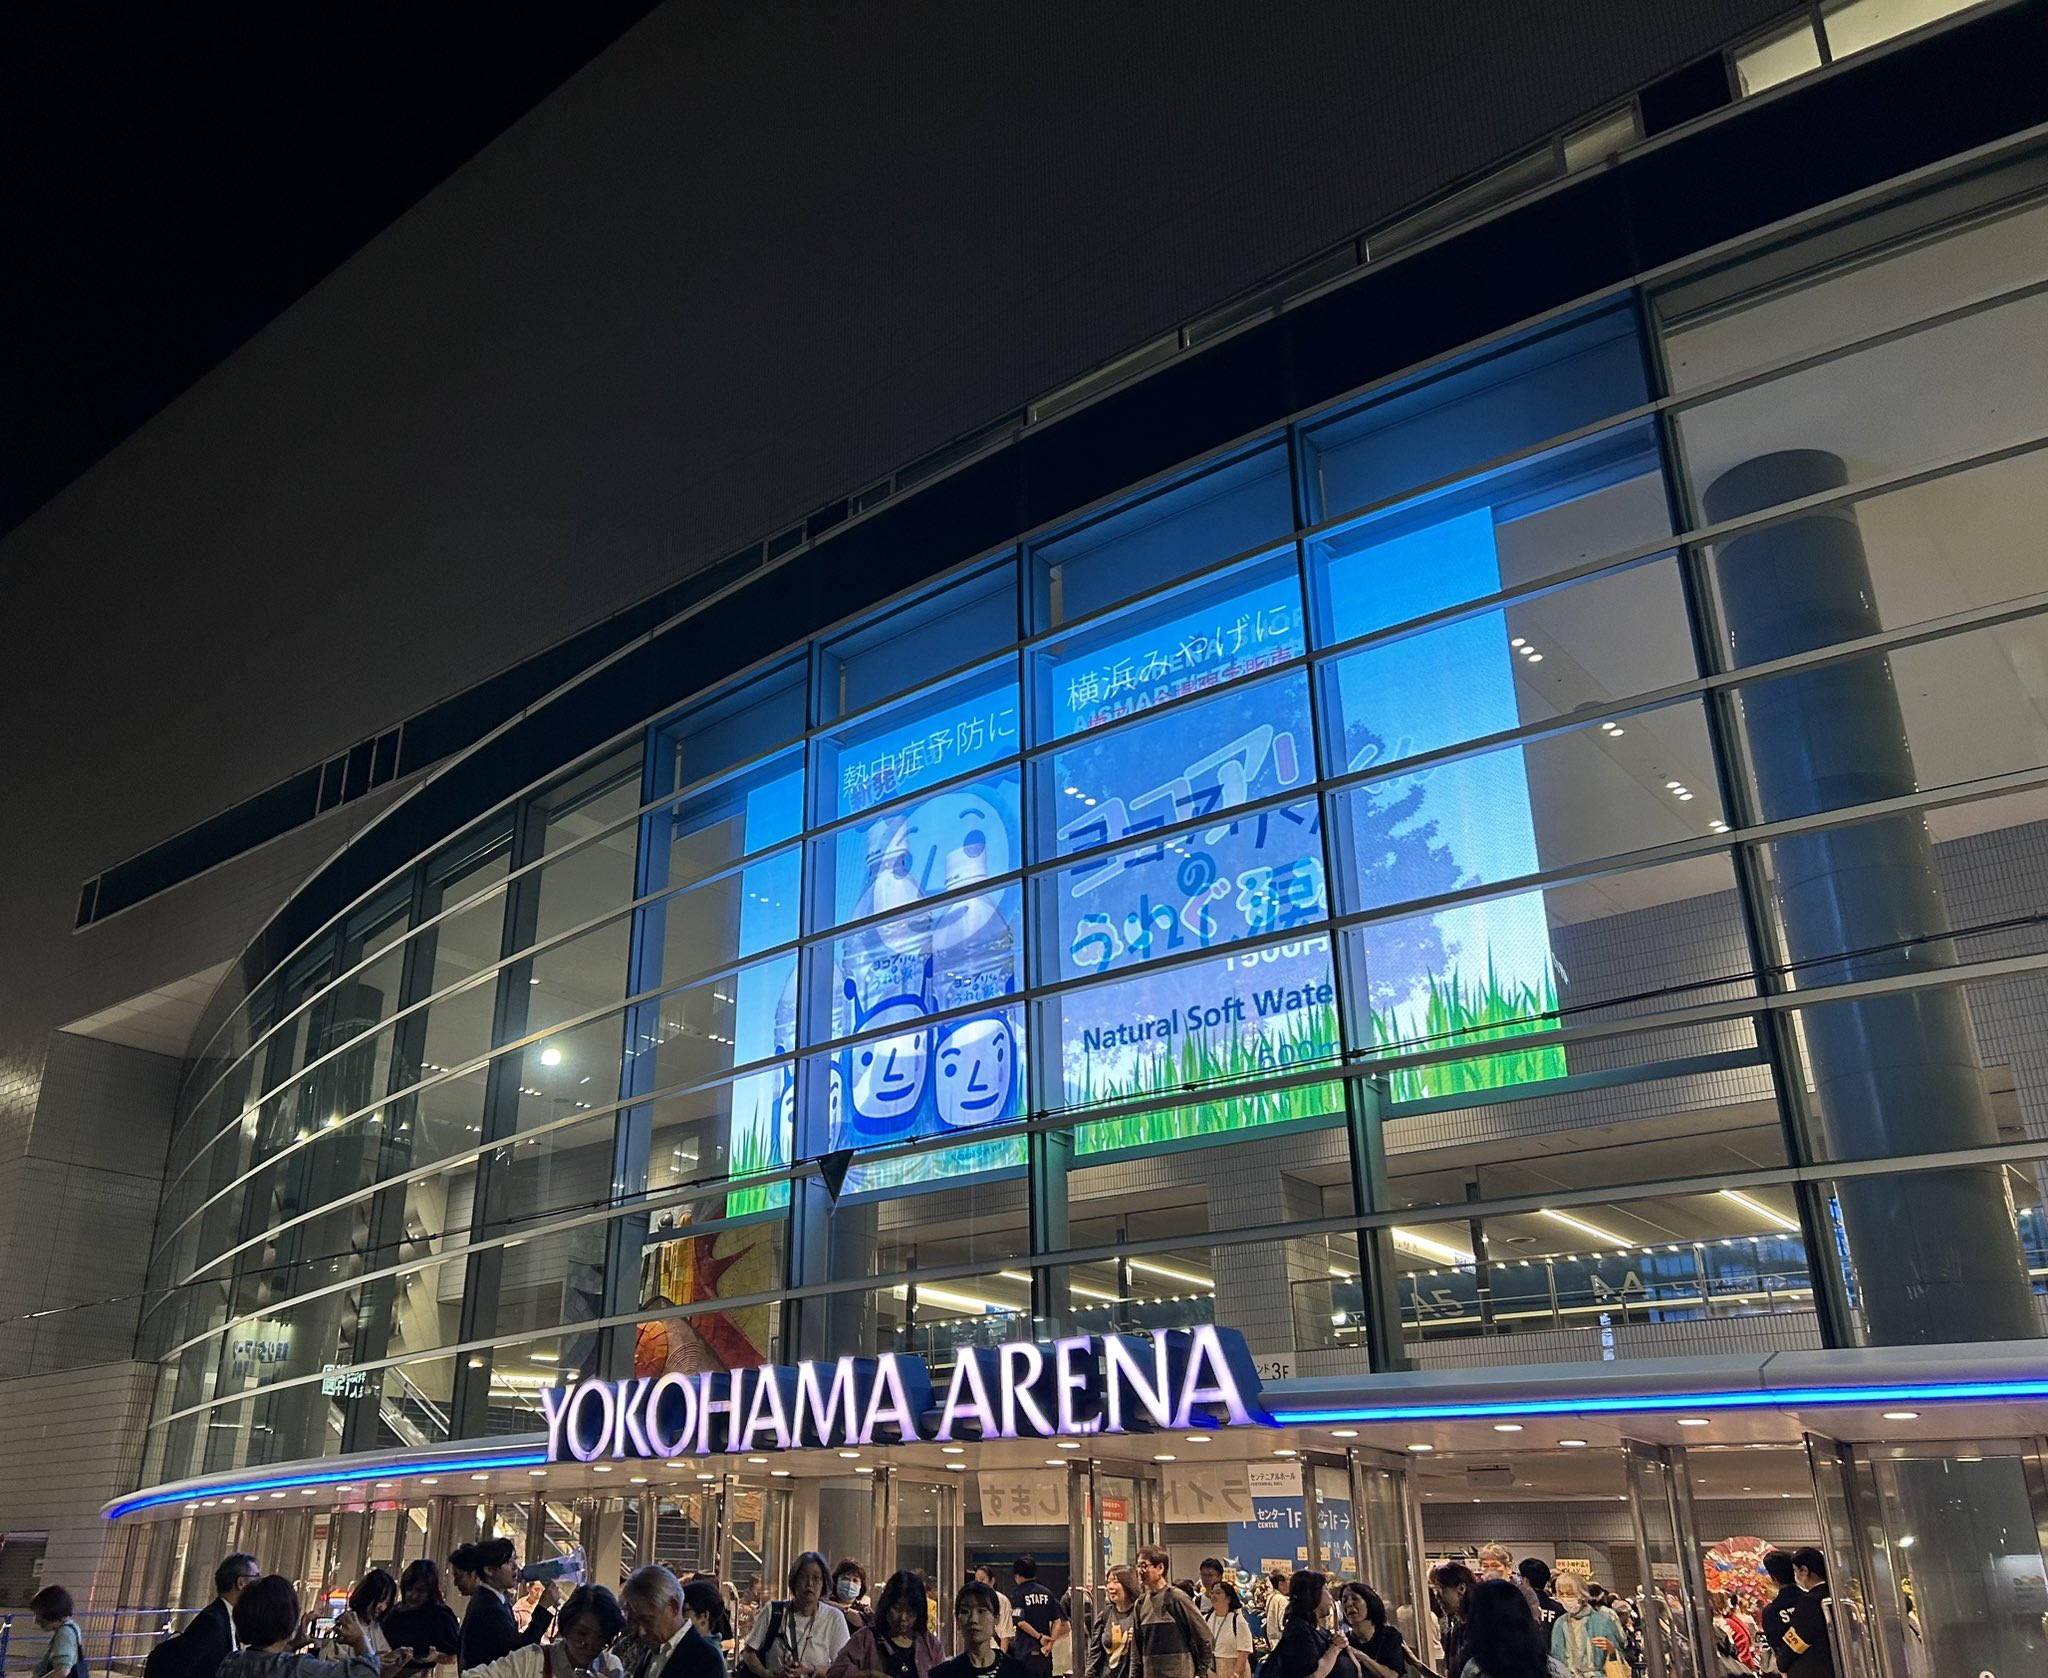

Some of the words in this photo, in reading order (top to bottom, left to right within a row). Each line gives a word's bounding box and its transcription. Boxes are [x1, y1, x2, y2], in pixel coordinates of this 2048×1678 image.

[1066, 605, 1290, 712] 横浜みやげに
[843, 708, 1015, 798] 熱中症予防に
[1083, 1009, 1179, 1053] Natural
[1188, 996, 1246, 1032] Soft
[1252, 983, 1334, 1018] Wate
[539, 1352, 920, 1463] YOKOHAMA
[932, 1323, 1254, 1441] ARENA
[1257, 1508, 1286, 1520] センター
[1025, 1593, 1049, 1606] STAFF
